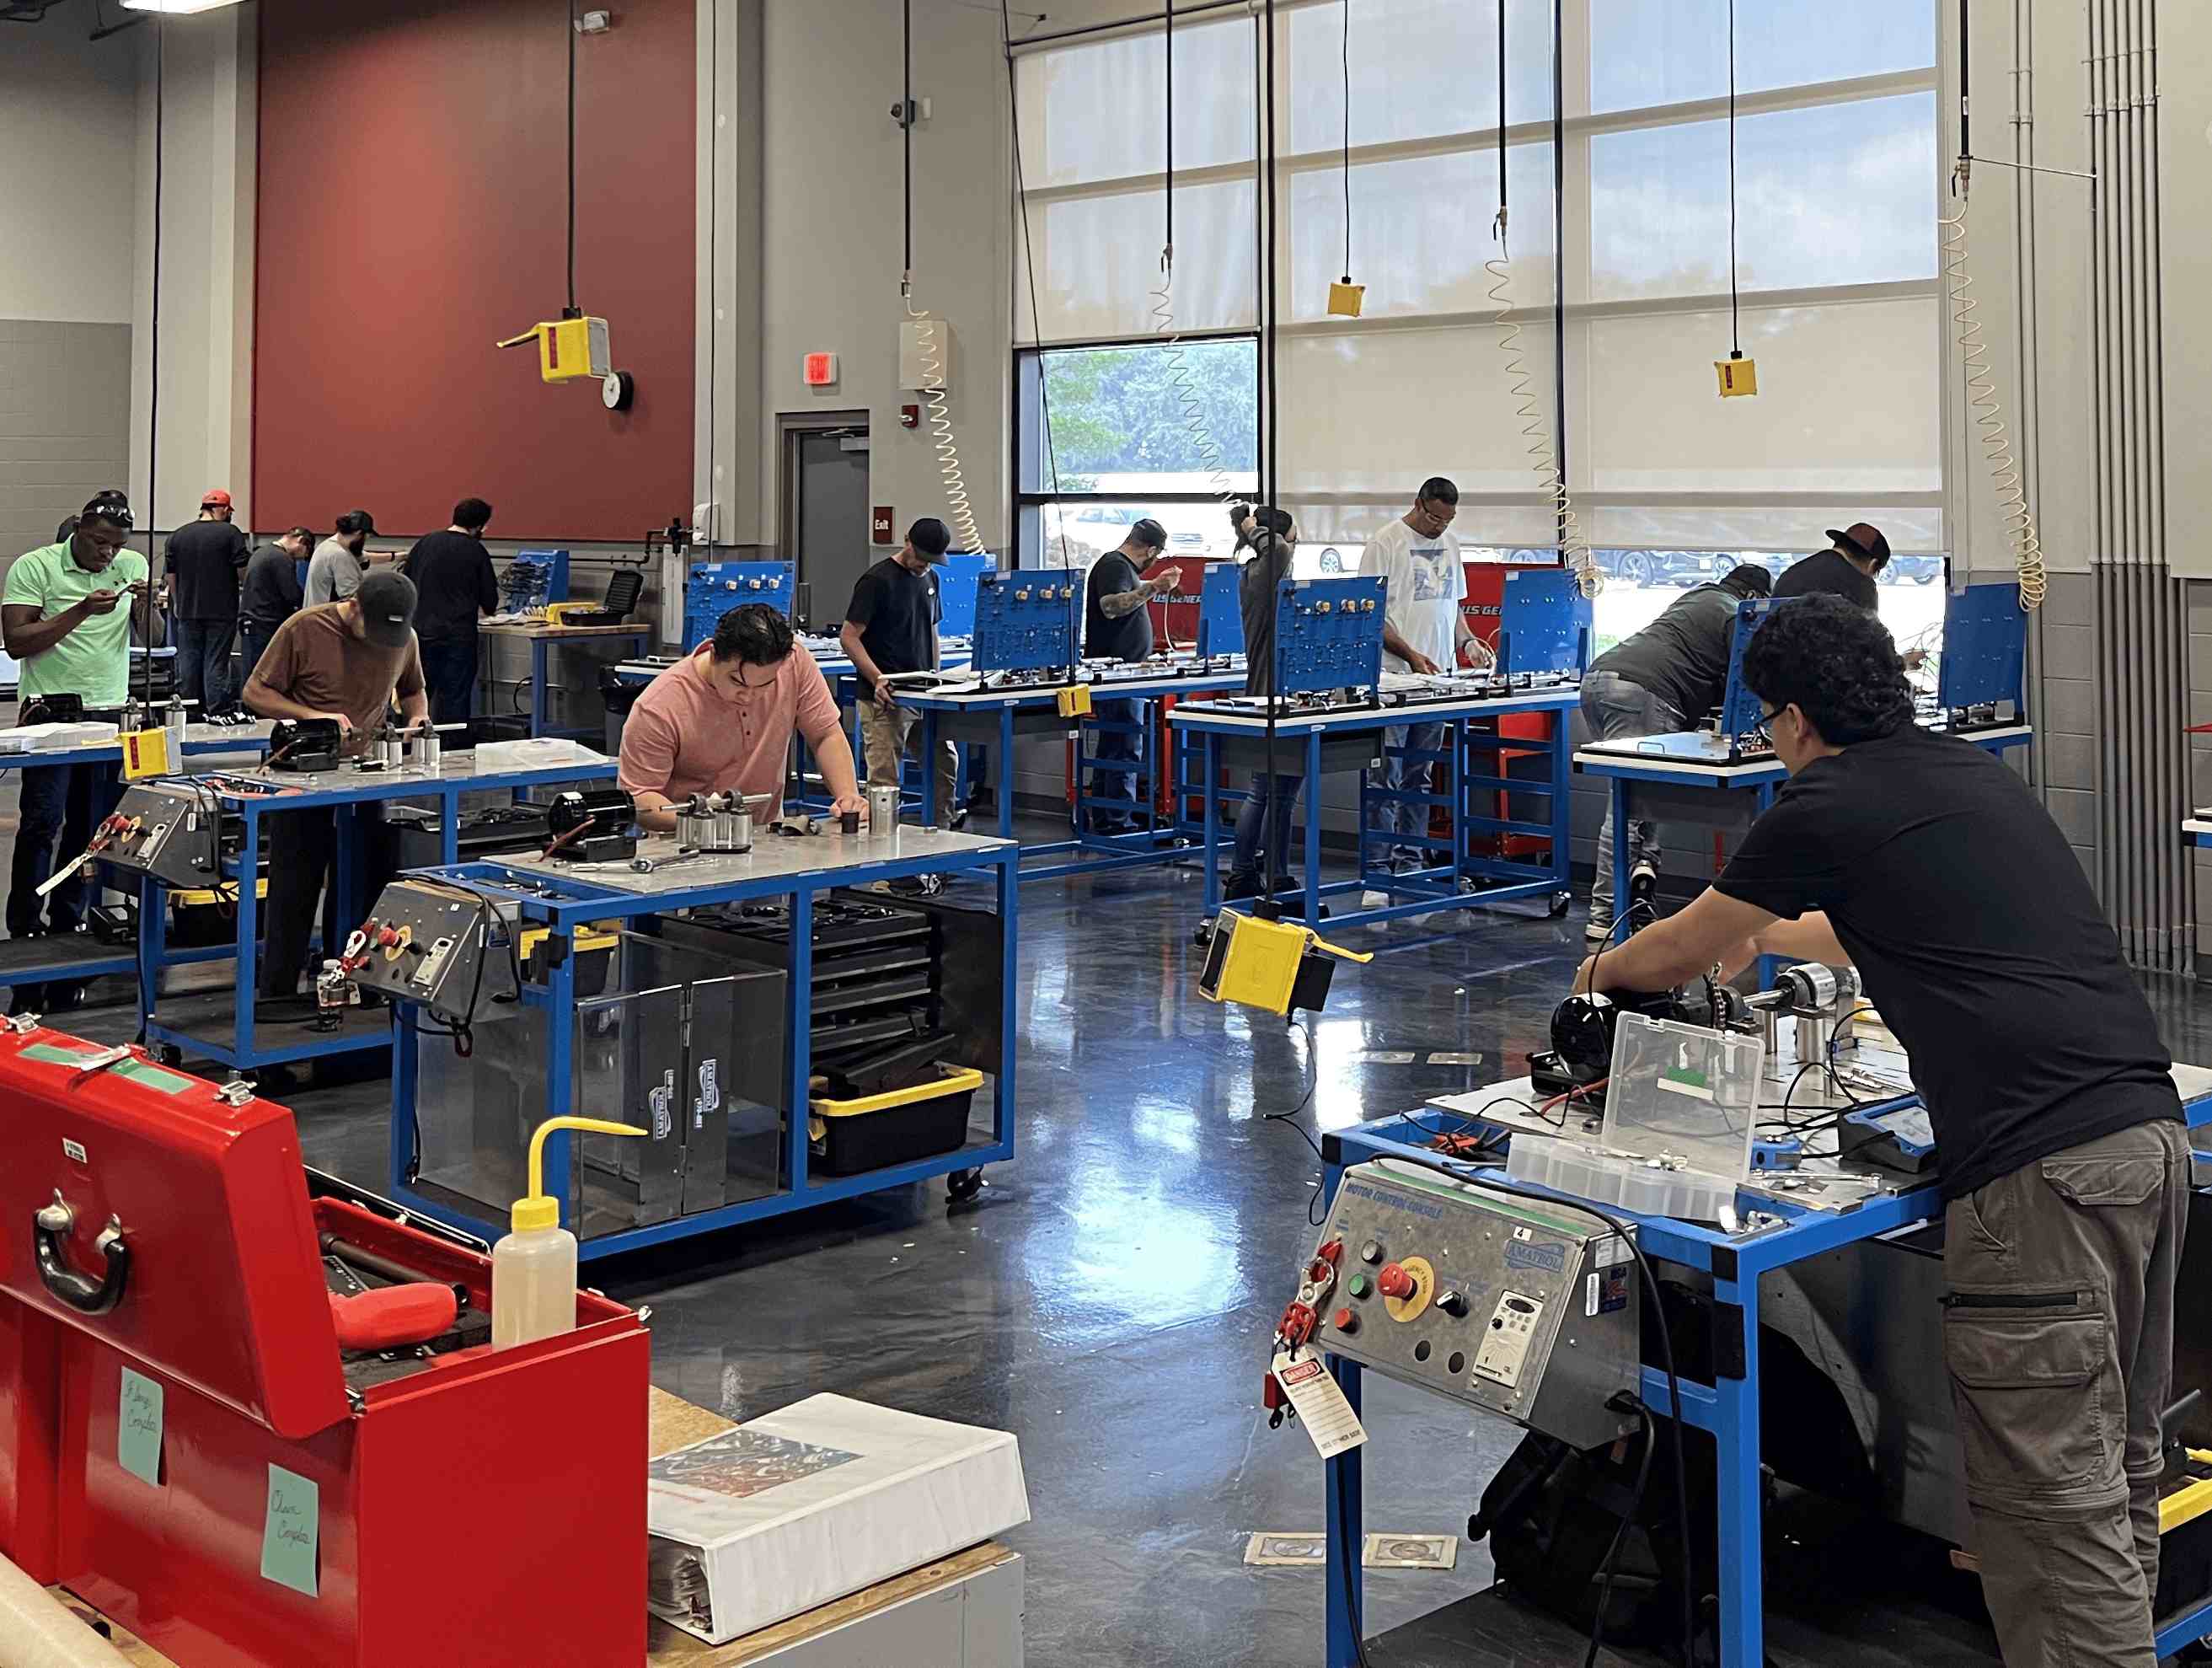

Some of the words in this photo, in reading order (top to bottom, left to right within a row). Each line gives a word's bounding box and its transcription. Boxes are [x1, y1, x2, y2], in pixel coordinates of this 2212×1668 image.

[1346, 1183, 1374, 1199] MOTOR
[1517, 1228, 1524, 1238] 4
[1512, 1246, 1561, 1269] AMATROL
